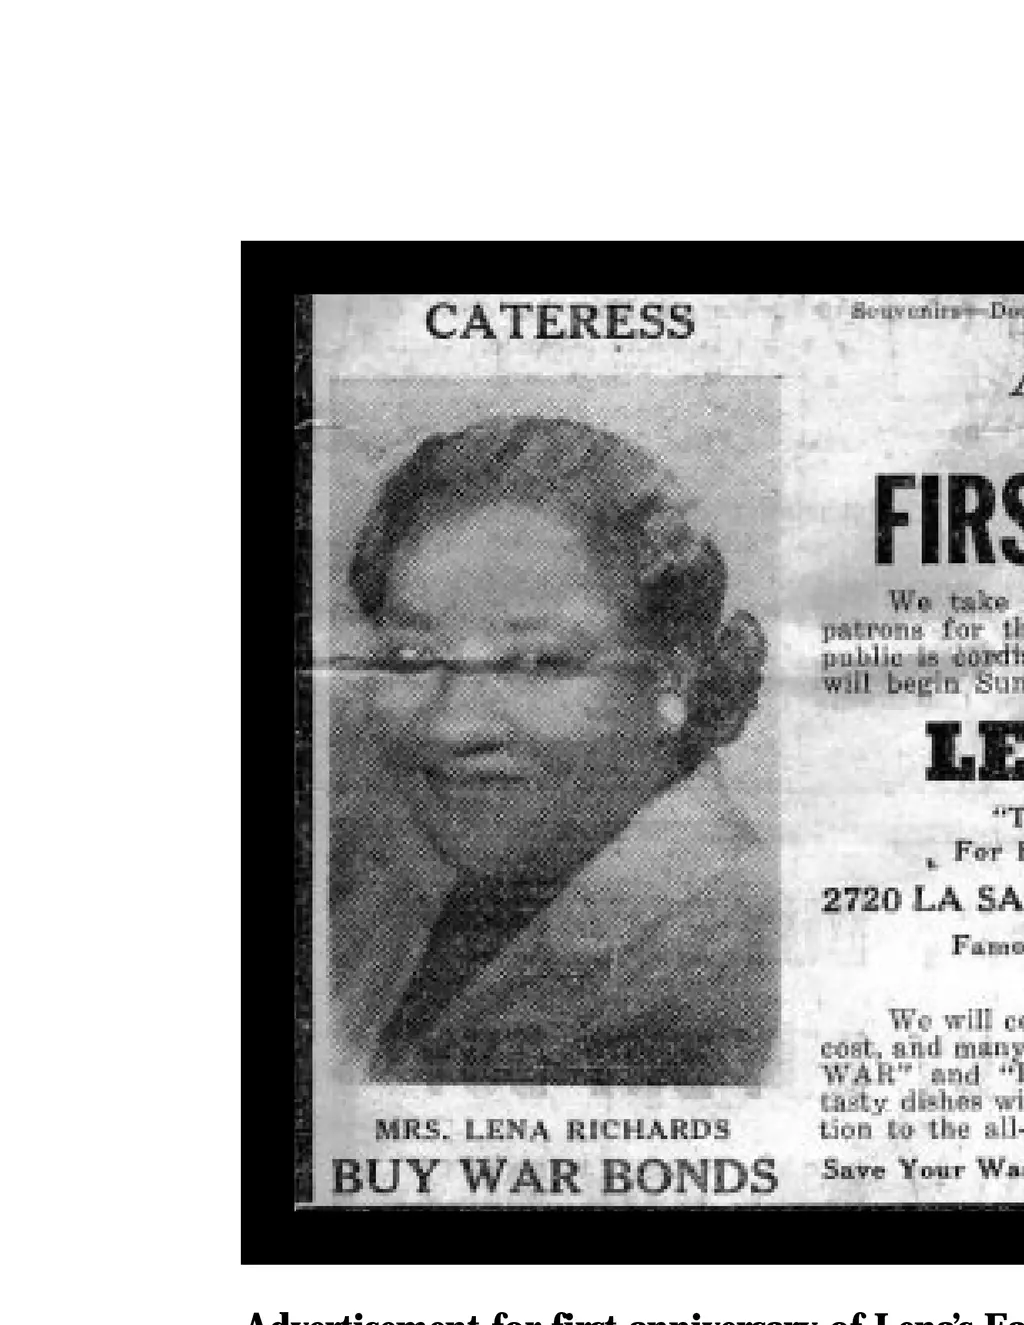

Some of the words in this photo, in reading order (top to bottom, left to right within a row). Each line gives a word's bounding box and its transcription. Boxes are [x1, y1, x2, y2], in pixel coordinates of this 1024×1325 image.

[426, 302, 695, 339] CATERESS
[955, 838, 1003, 862] For
[822, 886, 901, 912] 2720
[912, 884, 966, 912] LA
[376, 1119, 451, 1139] MRS.
[465, 1119, 550, 1141] LENA
[566, 1119, 731, 1140] RICHARDS
[332, 1158, 441, 1194] BUY
[459, 1158, 582, 1194] WAR
[602, 1158, 778, 1195] BONDS
[821, 1156, 888, 1180] Save
[898, 1156, 966, 1180] Your
